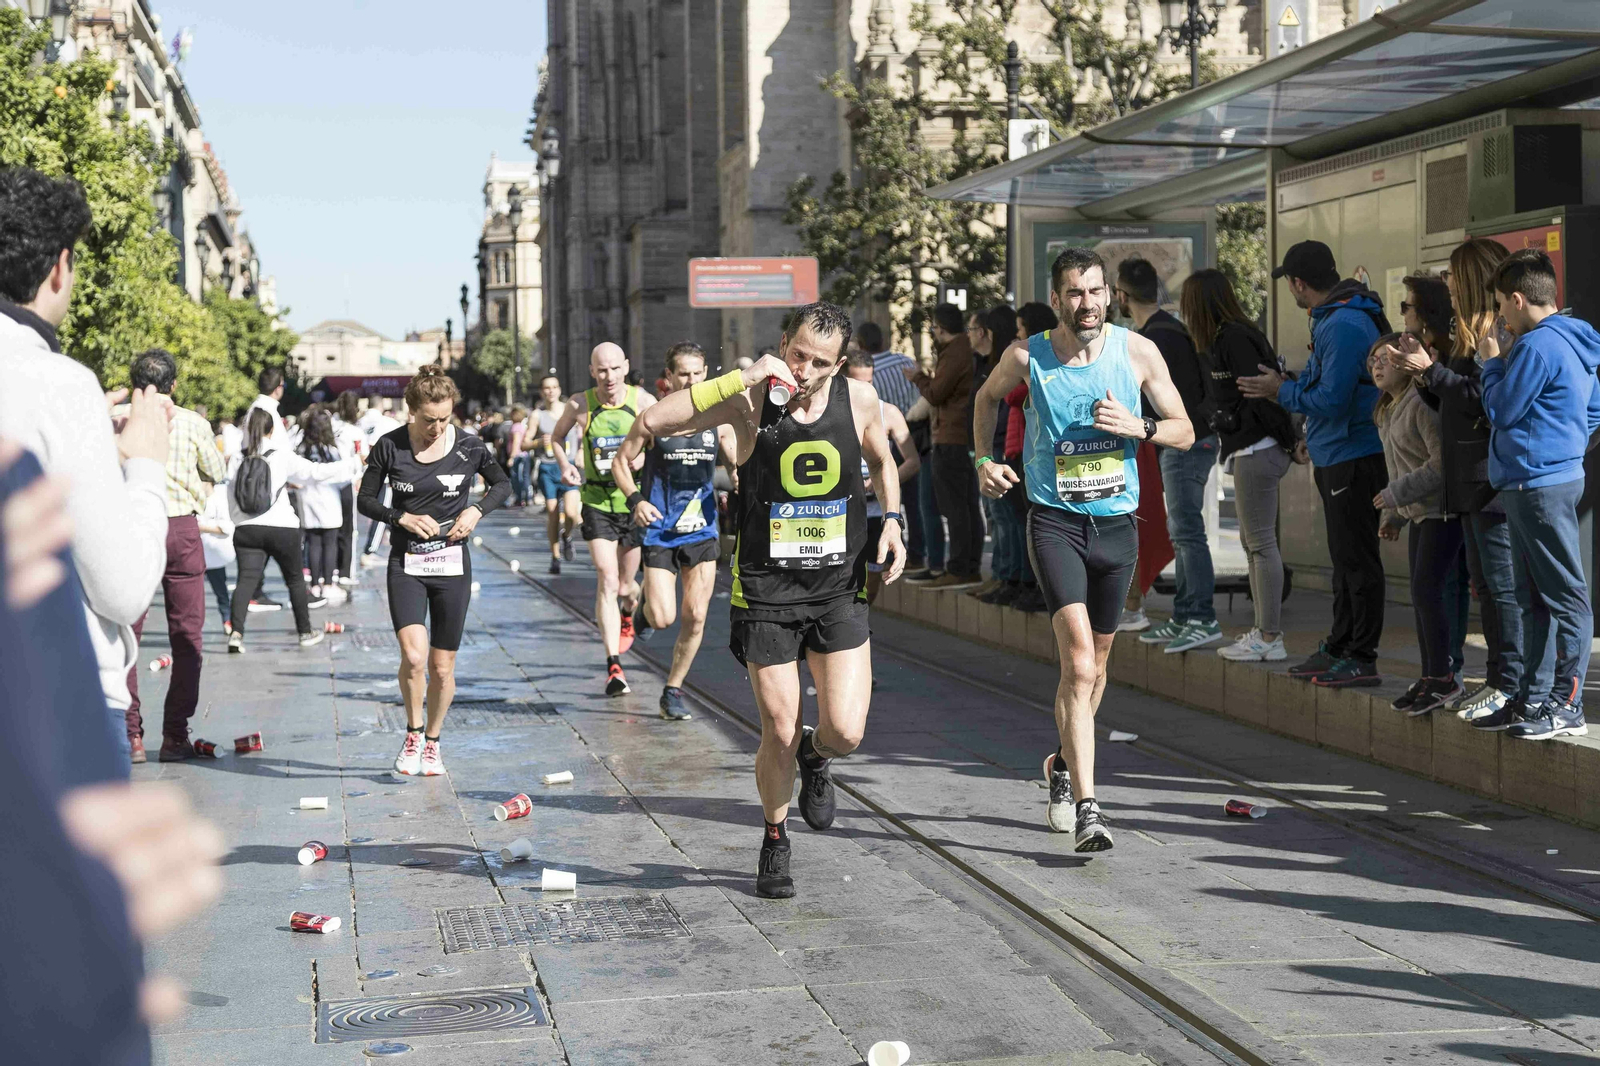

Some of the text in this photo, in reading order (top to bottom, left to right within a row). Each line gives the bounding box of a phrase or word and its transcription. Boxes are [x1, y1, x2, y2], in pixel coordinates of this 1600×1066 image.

[946, 288, 967, 311] 4
[1077, 439, 1117, 452] ZURICH
[1080, 461, 1102, 473] 790
[1058, 474, 1124, 489] MOISESALVARADO
[797, 504, 840, 515] ZURICH
[796, 526, 826, 538] 1006
[799, 545, 823, 554] EMILI
